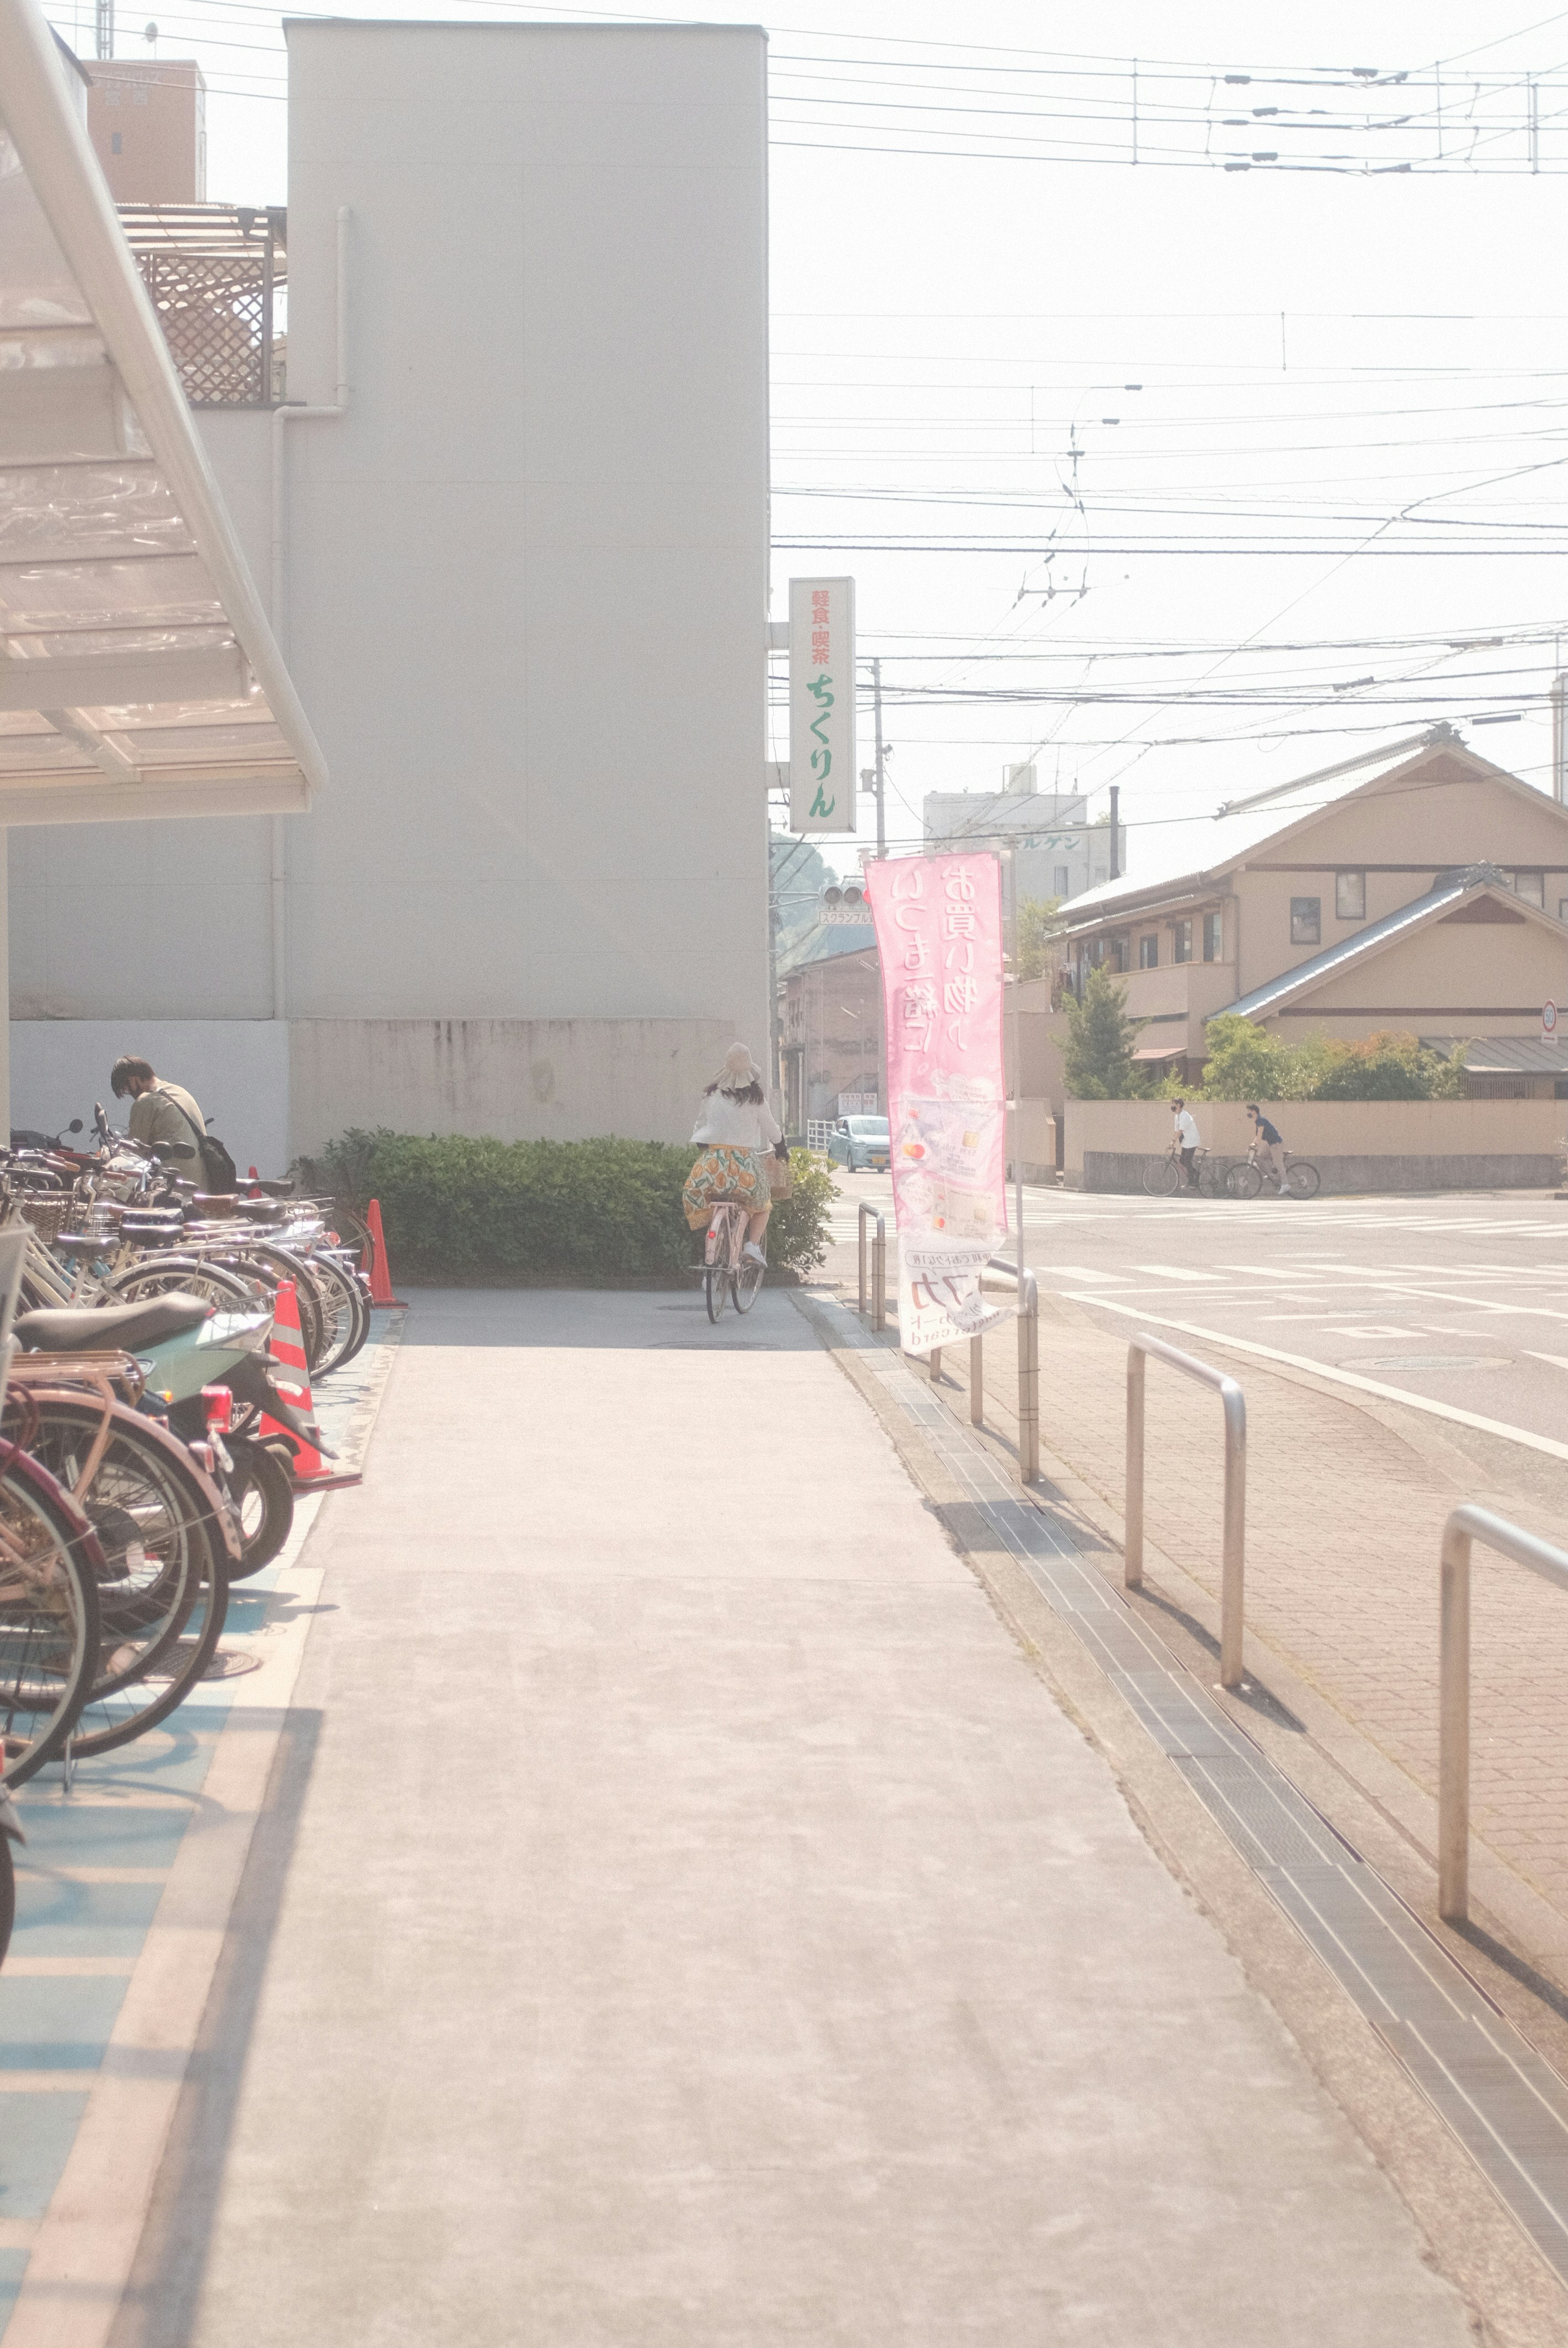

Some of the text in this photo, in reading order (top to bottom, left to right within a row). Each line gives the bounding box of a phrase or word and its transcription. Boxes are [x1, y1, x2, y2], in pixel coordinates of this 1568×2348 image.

[811, 590, 829, 665] 軽食・喫茶
[806, 674, 835, 817] ちくりん
[1545, 1008, 1554, 1023] 50
